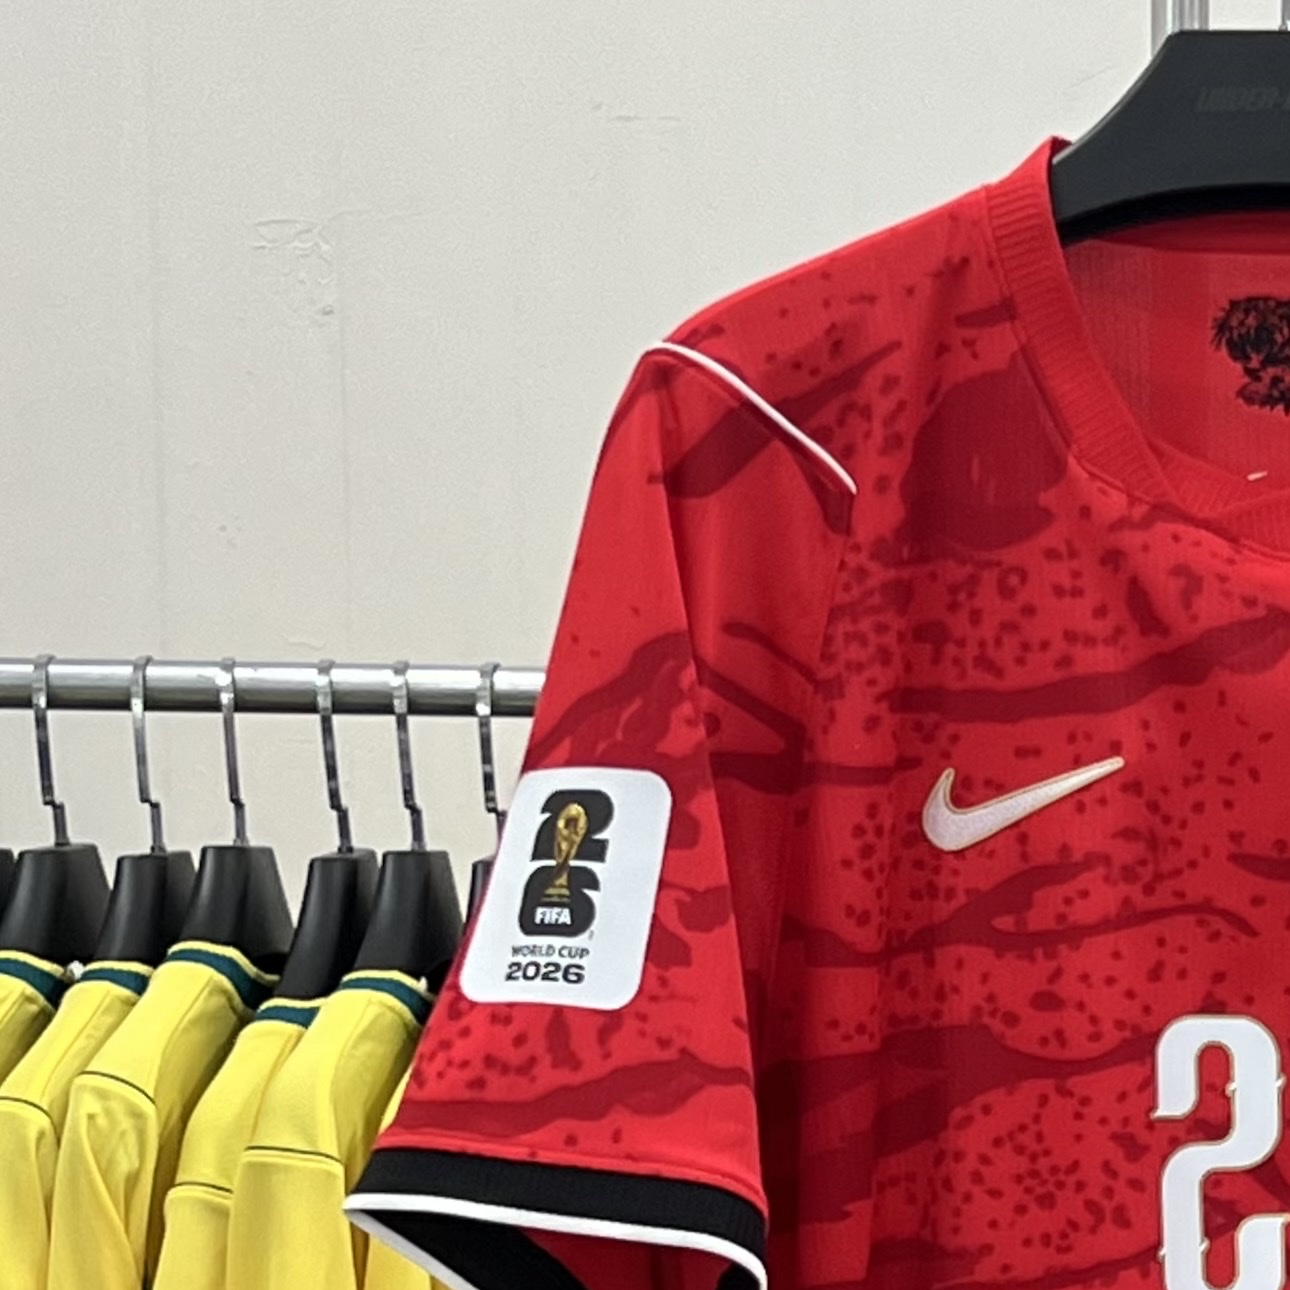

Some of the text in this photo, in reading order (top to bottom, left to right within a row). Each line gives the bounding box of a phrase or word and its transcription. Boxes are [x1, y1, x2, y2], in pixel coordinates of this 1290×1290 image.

[534, 906, 572, 925] FIFA
[511, 945, 590, 959] WORLD CUP
[505, 961, 585, 985] 2026
